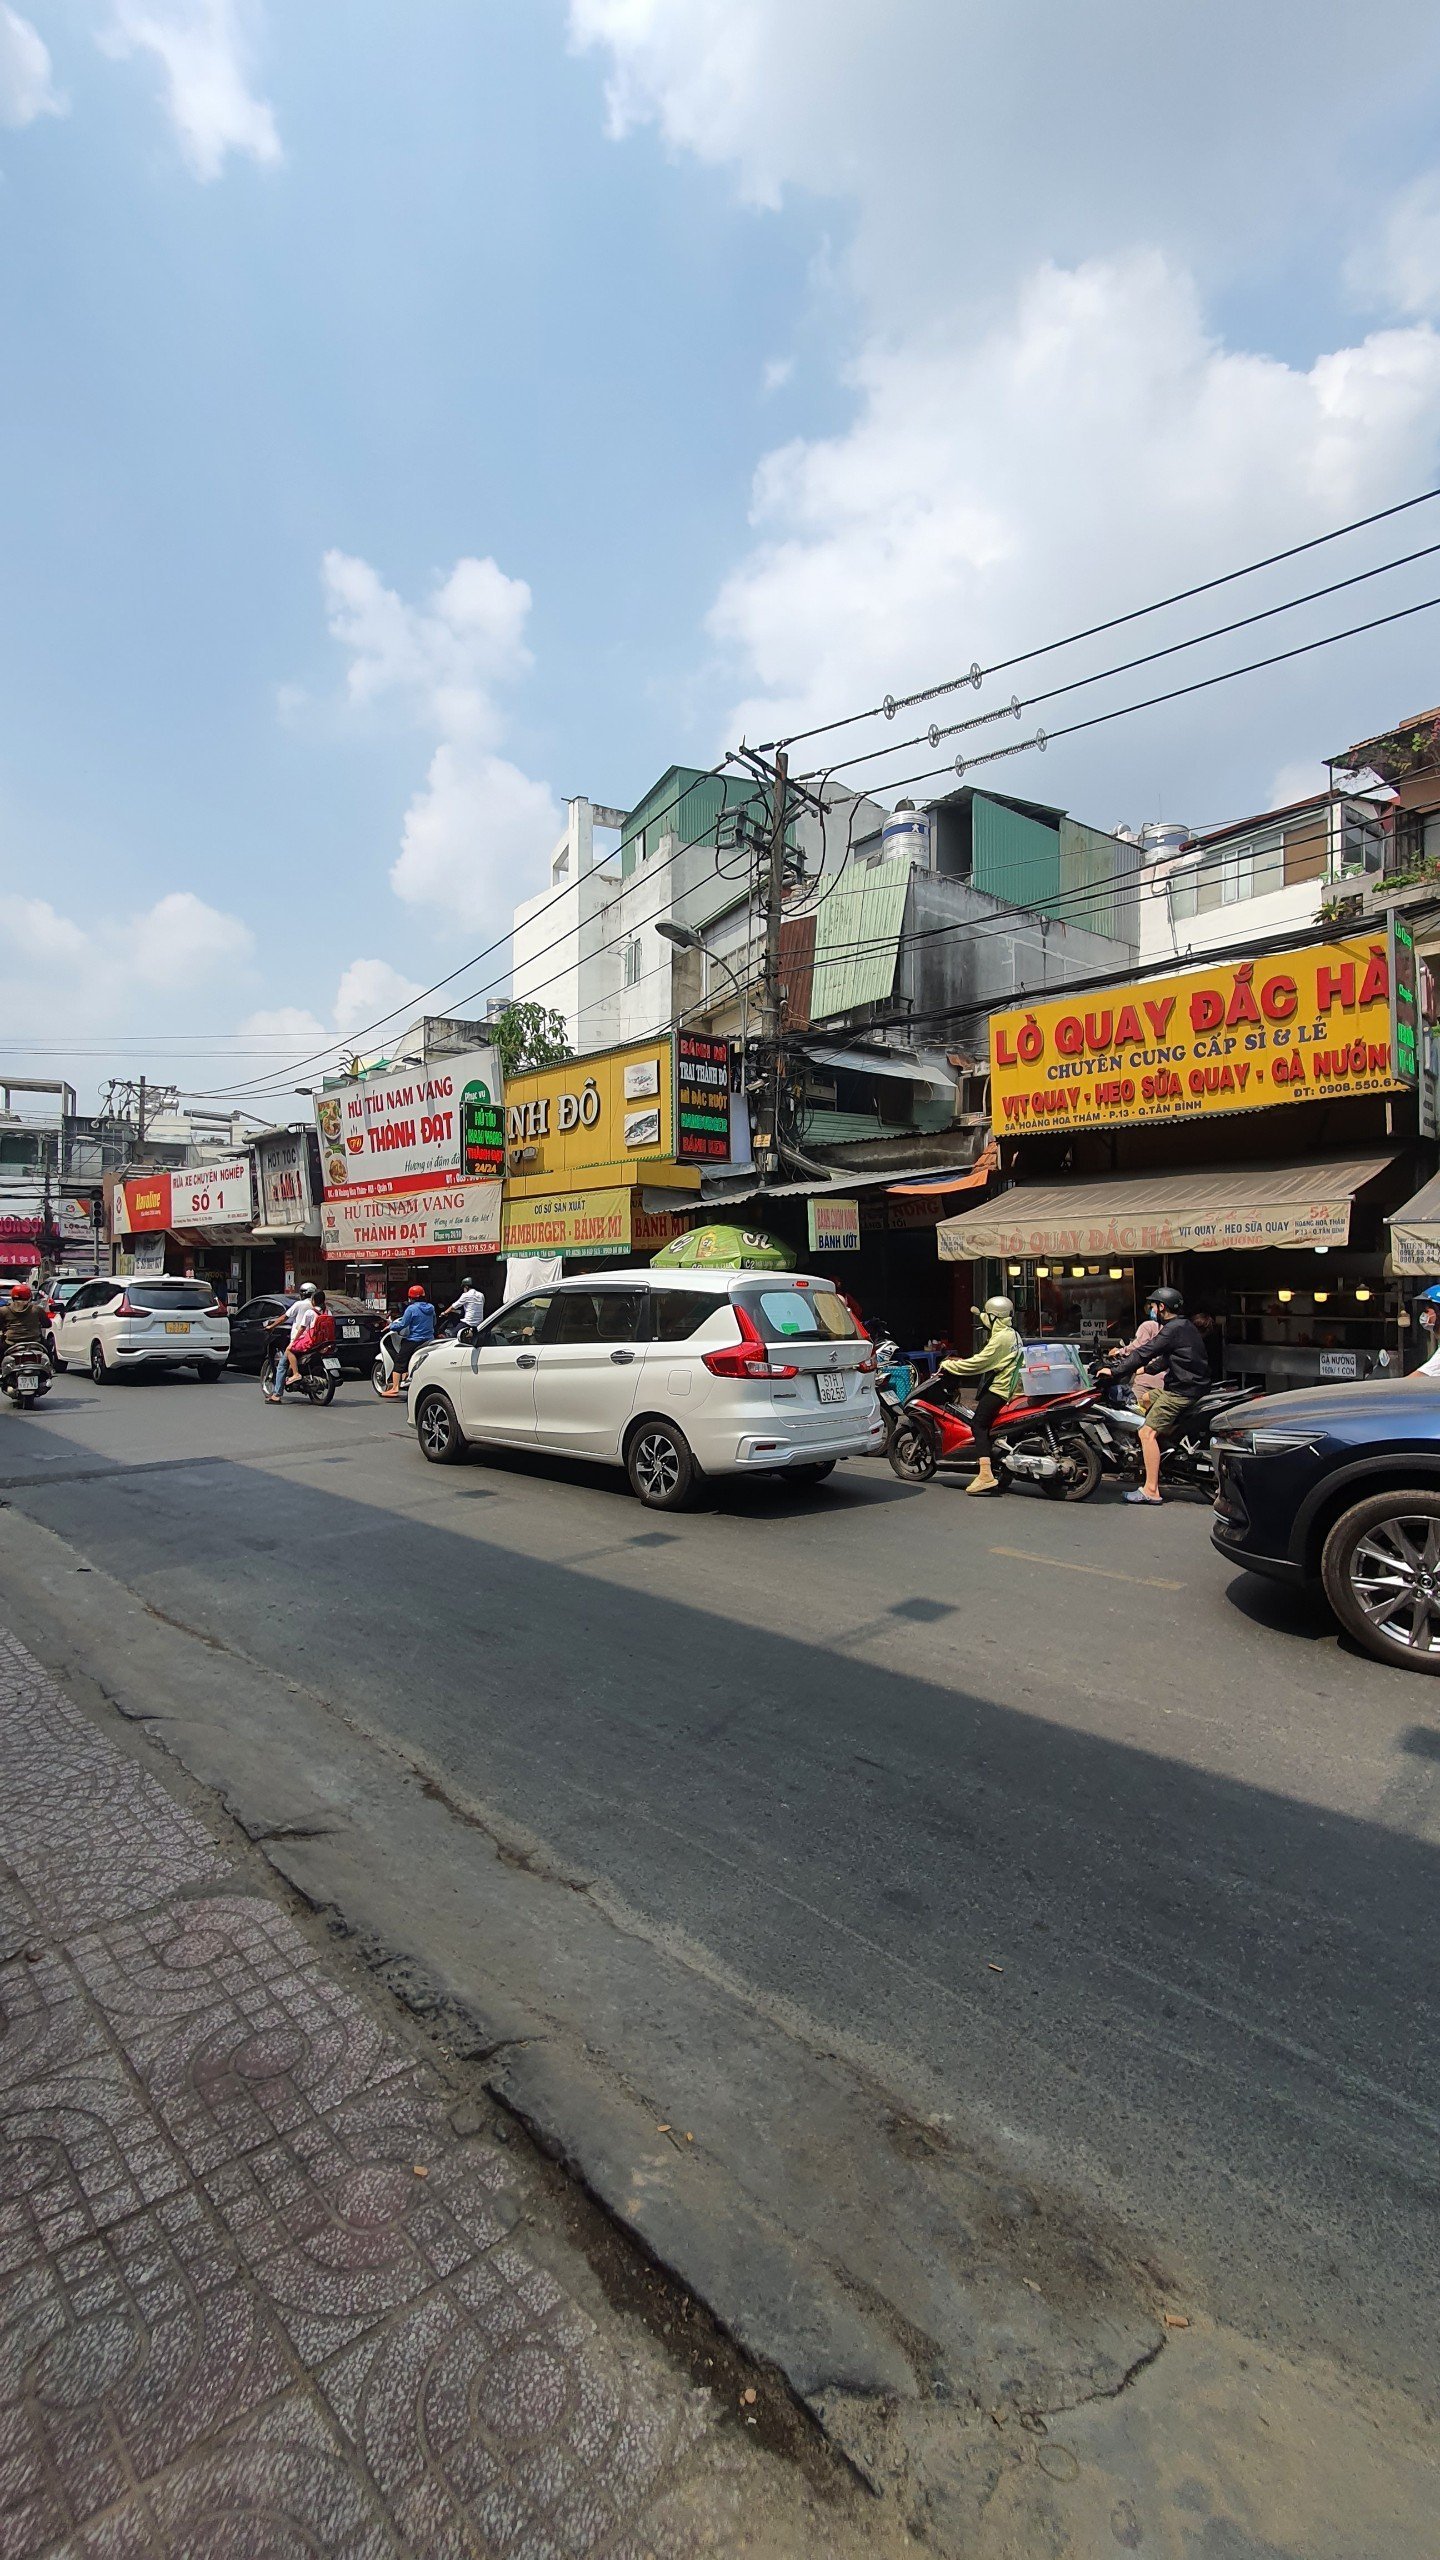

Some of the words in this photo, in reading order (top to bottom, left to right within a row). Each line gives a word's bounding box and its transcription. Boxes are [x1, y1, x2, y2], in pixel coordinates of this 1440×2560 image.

[996, 1014, 1043, 1064] LÒ
[1054, 996, 1176, 1054] QUAY
[1189, 962, 1298, 1032] ĐẮC
[1316, 945, 1389, 1010] HÀ
[680, 1038, 711, 1059] BÁNH
[1047, 1054, 1122, 1080] CHUYÊN
[1129, 1045, 1186, 1070] CUNG
[1193, 1032, 1237, 1058] CẤP
[1244, 1025, 1266, 1051] SỈ
[1273, 1028, 1291, 1046] &
[1298, 1016, 1328, 1043] LẺ
[680, 1061, 696, 1080] TRAI
[696, 1061, 718, 1084] THÀNH
[718, 1065, 728, 1086] ĐÔ
[1002, 1094, 1030, 1122] VỊT
[1031, 1086, 1081, 1113] QUAY
[1095, 1079, 1135, 1104] HEO
[1141, 1068, 1183, 1098] SỮA
[1188, 1063, 1250, 1093] QUAY
[1271, 1048, 1304, 1082] GÀ
[348, 1093, 362, 1119] HỦ
[364, 1090, 384, 1114] TÍU
[386, 1087, 414, 1109] NAM
[416, 1076, 453, 1103] VANG
[557, 1077, 599, 1130] ĐÔ
[691, 1089, 708, 1109] ĐẶC
[681, 1112, 728, 1133] HAMBURGER
[1005, 1122, 1016, 1131] 5A
[1019, 1118, 1050, 1130] HOÀNG
[1052, 1115, 1071, 1126] HOA
[1109, 1109, 1129, 1119] P.13
[1138, 1102, 1170, 1115] Q.TÂN
[1174, 1100, 1202, 1111] BÌNH
[367, 1119, 415, 1153] THÀNH
[421, 1111, 453, 1149] ĐẠT
[683, 1134, 707, 1153] BÁNH
[185, 1175, 192, 1186] XE
[194, 1168, 217, 1185] CHUYÊN
[220, 1164, 245, 1181] NGHIỆP
[475, 1163, 497, 1173] 24/24
[192, 1185, 210, 1211] SỐ
[217, 1190, 224, 1209] 1
[387, 1199, 418, 1216] NAM
[422, 1193, 464, 1213] VANG
[1310, 1205, 1330, 1219] 5A
[354, 1222, 396, 1242] THÀNH
[400, 1222, 427, 1244] ĐẠT
[503, 1220, 566, 1246] HAMBURGER
[574, 1213, 605, 1241] BÁNH
[1000, 1228, 1024, 1253] LÒ
[1029, 1230, 1083, 1253] QUAY
[1088, 1217, 1135, 1250] ĐẮC
[1141, 1218, 1174, 1249] HÀ
[1179, 1226, 1192, 1237] VỊT
[1194, 1225, 1217, 1236] QUAY
[1225, 1223, 1243, 1234] HEO
[1245, 1221, 1263, 1233] SỮA
[1265, 1221, 1290, 1233] QUAY
[818, 1232, 841, 1249] BÁNH
[843, 1232, 858, 1249] ƯỚT
[408, 1248, 415, 1256] TB
[824, 1374, 839, 1387] 51H
[1341, 1366, 1355, 1376] CON
[820, 1386, 847, 1402] 362.55
